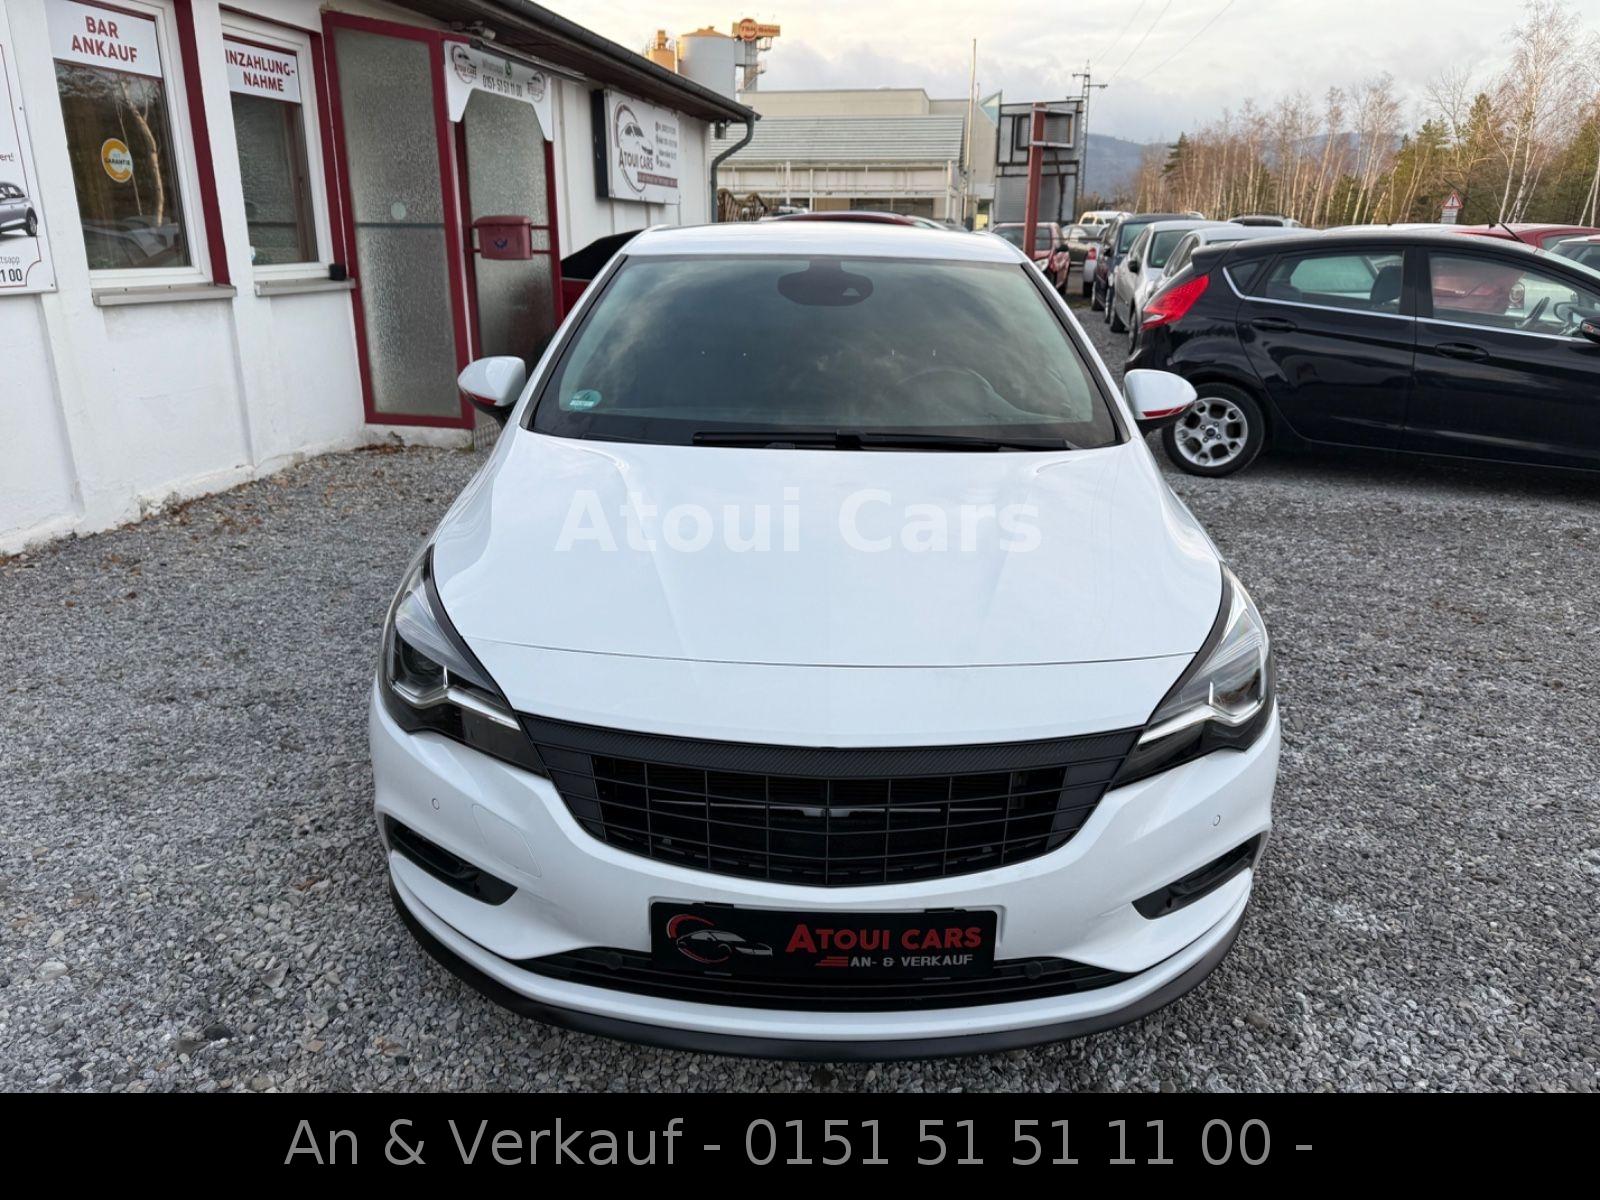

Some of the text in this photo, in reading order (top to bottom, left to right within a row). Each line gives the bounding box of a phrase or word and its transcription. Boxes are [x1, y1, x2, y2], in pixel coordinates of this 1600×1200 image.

[85, 15, 119, 39] BAR
[71, 35, 137, 63] ANKAUF
[224, 49, 296, 76] INZAHLUNG-
[243, 71, 284, 92] NAHME
[618, 147, 639, 169] ATOUI
[640, 154, 654, 171] CARS
[9, 268, 23, 282] 00
[785, 924, 982, 953] ATOUI CARS
[850, 953, 974, 968] AN- & VERKAUF
